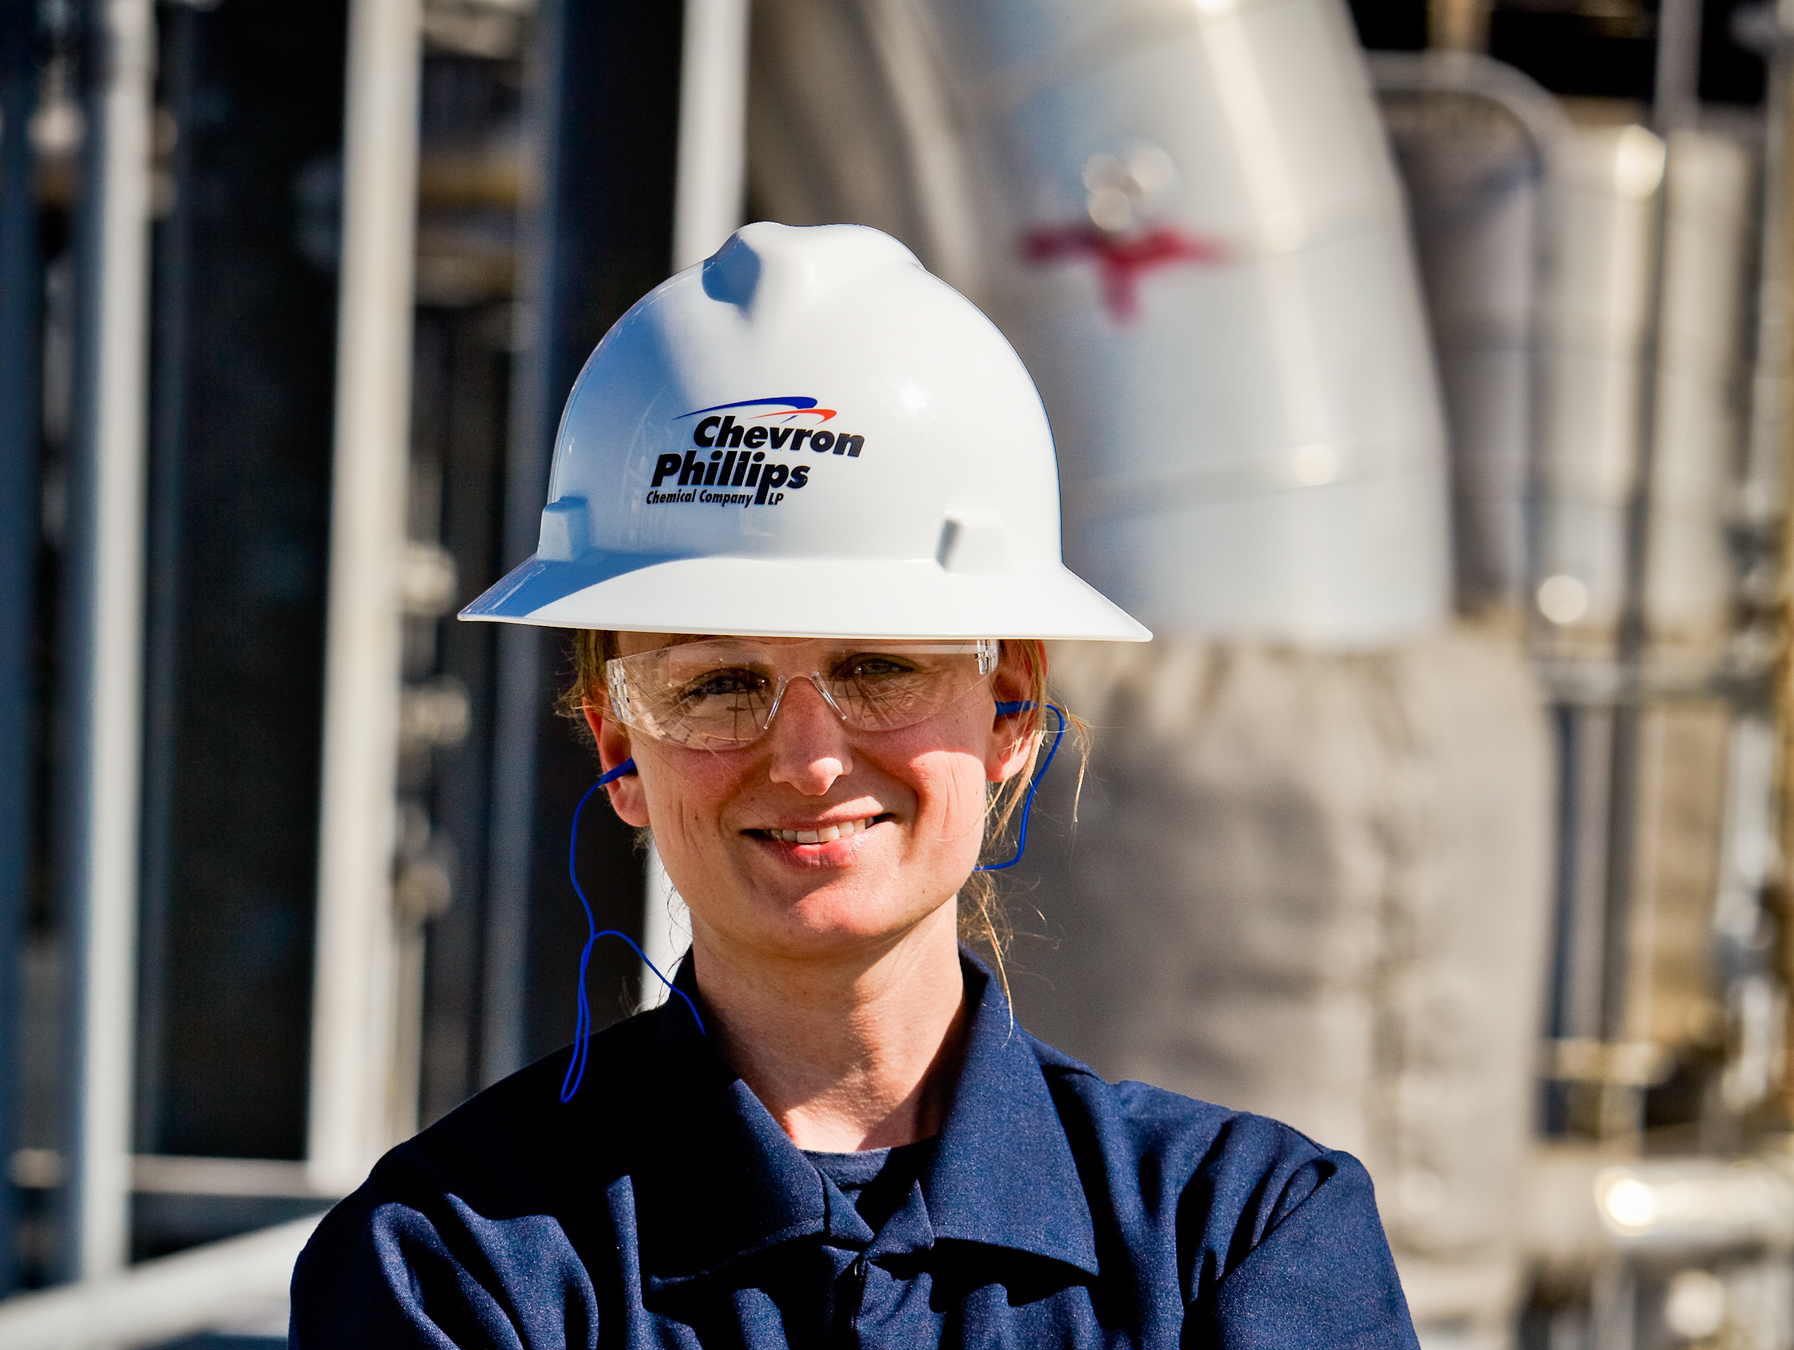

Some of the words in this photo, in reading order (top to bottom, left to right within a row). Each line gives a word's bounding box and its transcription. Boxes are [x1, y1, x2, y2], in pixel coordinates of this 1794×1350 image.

[693, 415, 865, 458] Chevron
[646, 489, 697, 505] Chemical
[699, 489, 754, 508] Company
[768, 492, 784, 505] LP
[651, 450, 811, 505] Phillips
